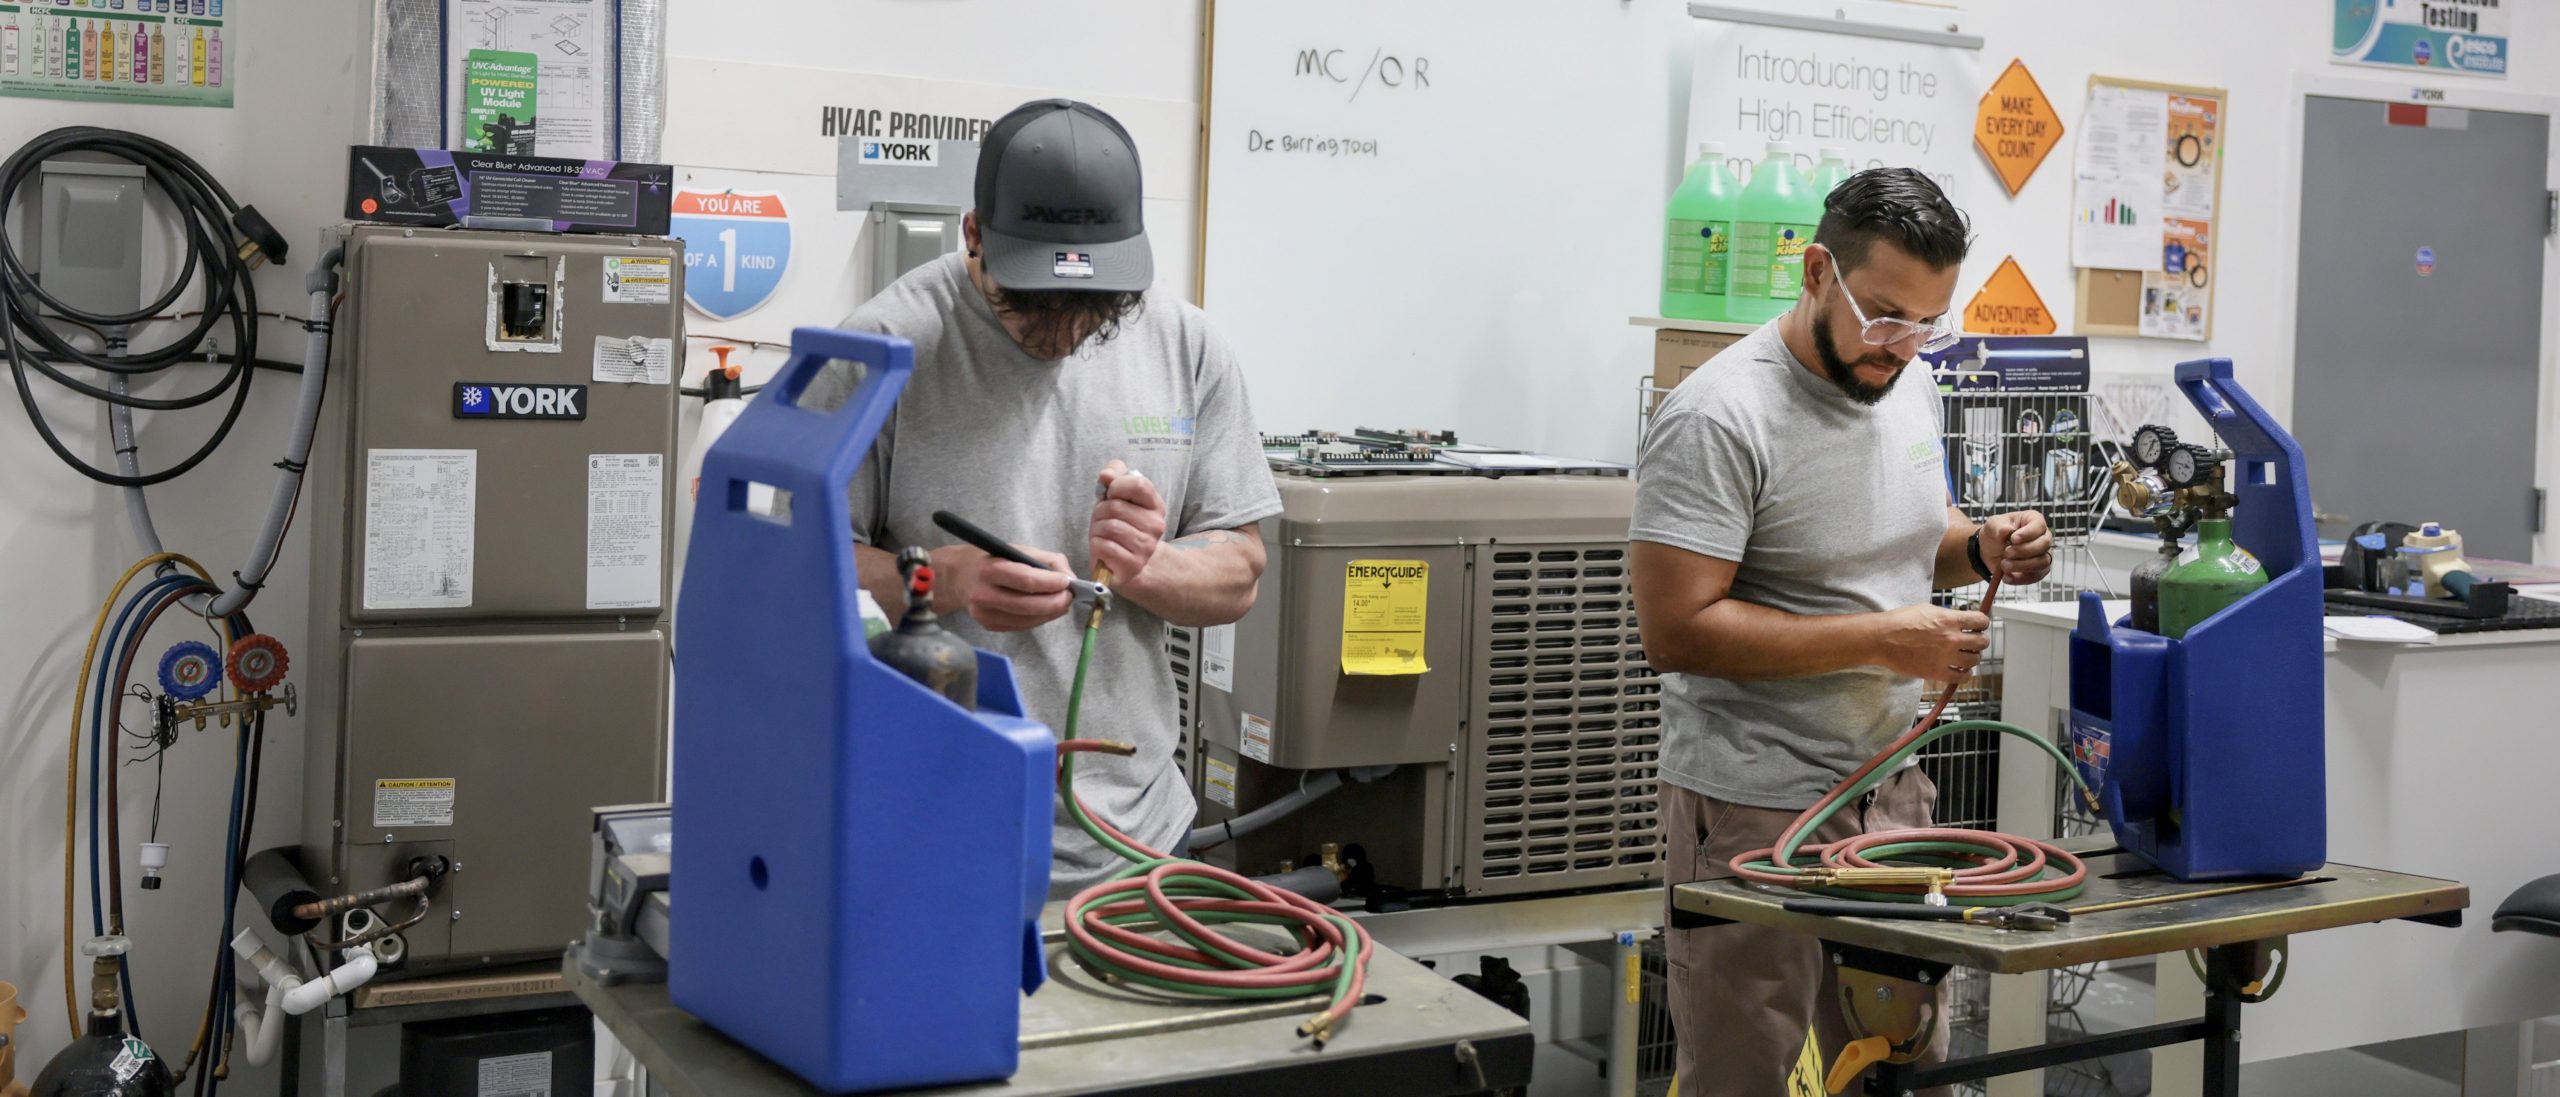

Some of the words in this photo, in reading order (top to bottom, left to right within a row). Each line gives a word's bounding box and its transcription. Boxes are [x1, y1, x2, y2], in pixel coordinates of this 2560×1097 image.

[2421, 3, 2478, 33] Testing
[1737, 44, 1890, 101] Introducing
[1898, 62, 1937, 98] the
[471, 78, 534, 89] POWERED
[480, 87, 496, 96] UV
[498, 88, 525, 99] Light
[483, 97, 522, 108] Module
[2000, 96, 2034, 115] MAKE
[822, 106, 882, 137] HVAC
[1738, 97, 1802, 142] High
[1812, 102, 1936, 154] Efficiency
[1986, 118, 2024, 136] EVERY
[2026, 120, 2047, 138] DAY
[881, 143, 931, 161] YORK
[1997, 139, 2036, 158] COUNT
[471, 159, 494, 168] Clear
[518, 162, 561, 173] Advanced
[563, 164, 584, 174] 18-32
[585, 167, 604, 175] VAC
[696, 198, 729, 212] YOU
[732, 200, 762, 214] ARE
[684, 252, 704, 267] OF
[706, 254, 718, 267] A
[719, 228, 736, 292] 1
[741, 255, 776, 270] KIND
[1973, 304, 2041, 325] ADVENTURE
[1990, 321, 2028, 336] AHEAD
[490, 386, 579, 415] YORK
[1348, 566, 1423, 579] ENERGYGUIDE
